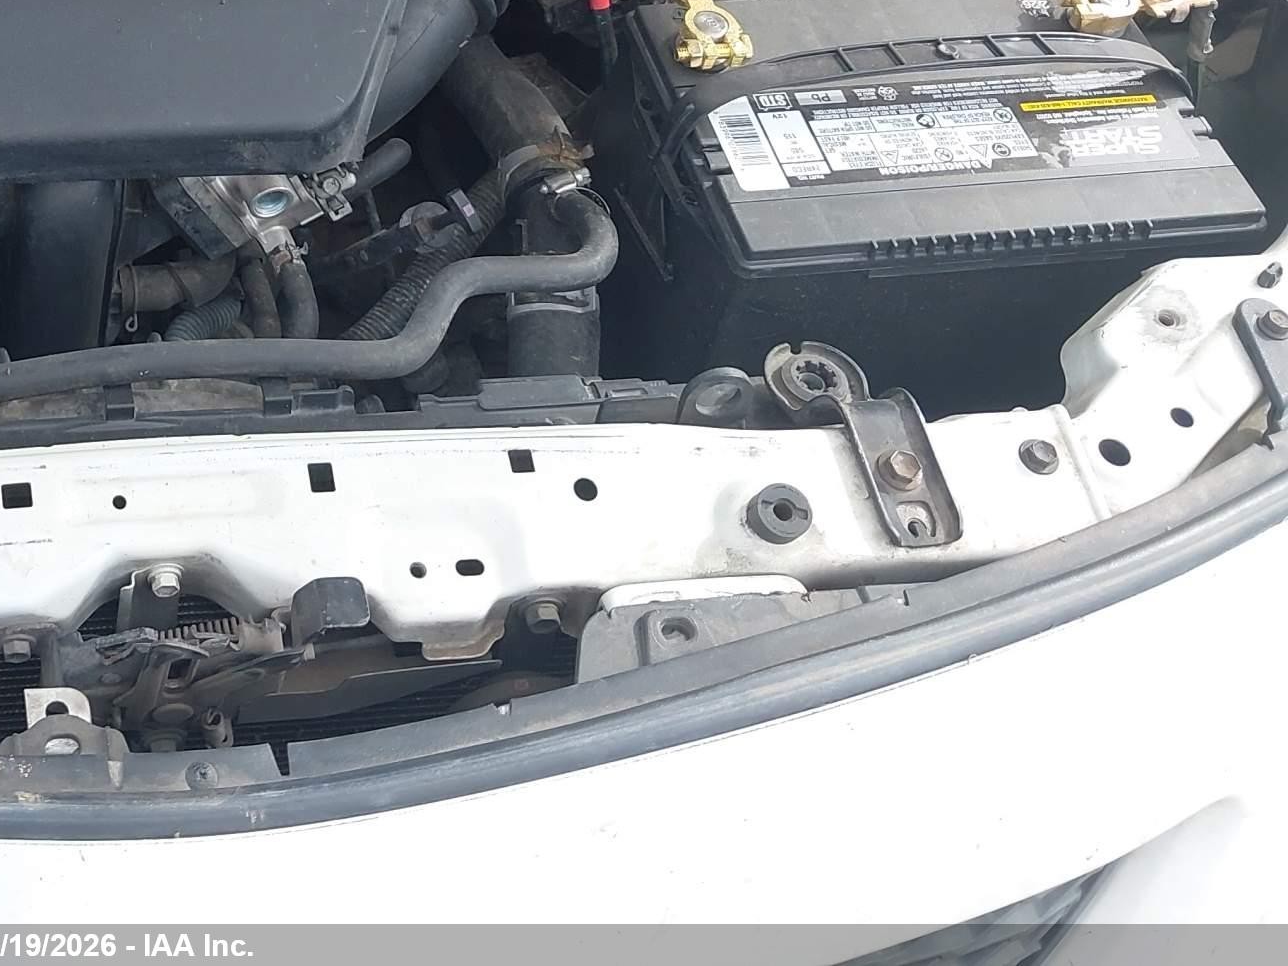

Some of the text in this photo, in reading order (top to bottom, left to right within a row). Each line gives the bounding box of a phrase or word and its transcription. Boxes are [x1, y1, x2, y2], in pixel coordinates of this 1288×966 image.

[758, 93, 787, 107] STD
[810, 92, 832, 102] Pb
[1060, 125, 1163, 146] START
[1070, 143, 1161, 158] SUPER
[878, 160, 982, 176] DANGER/POISON
